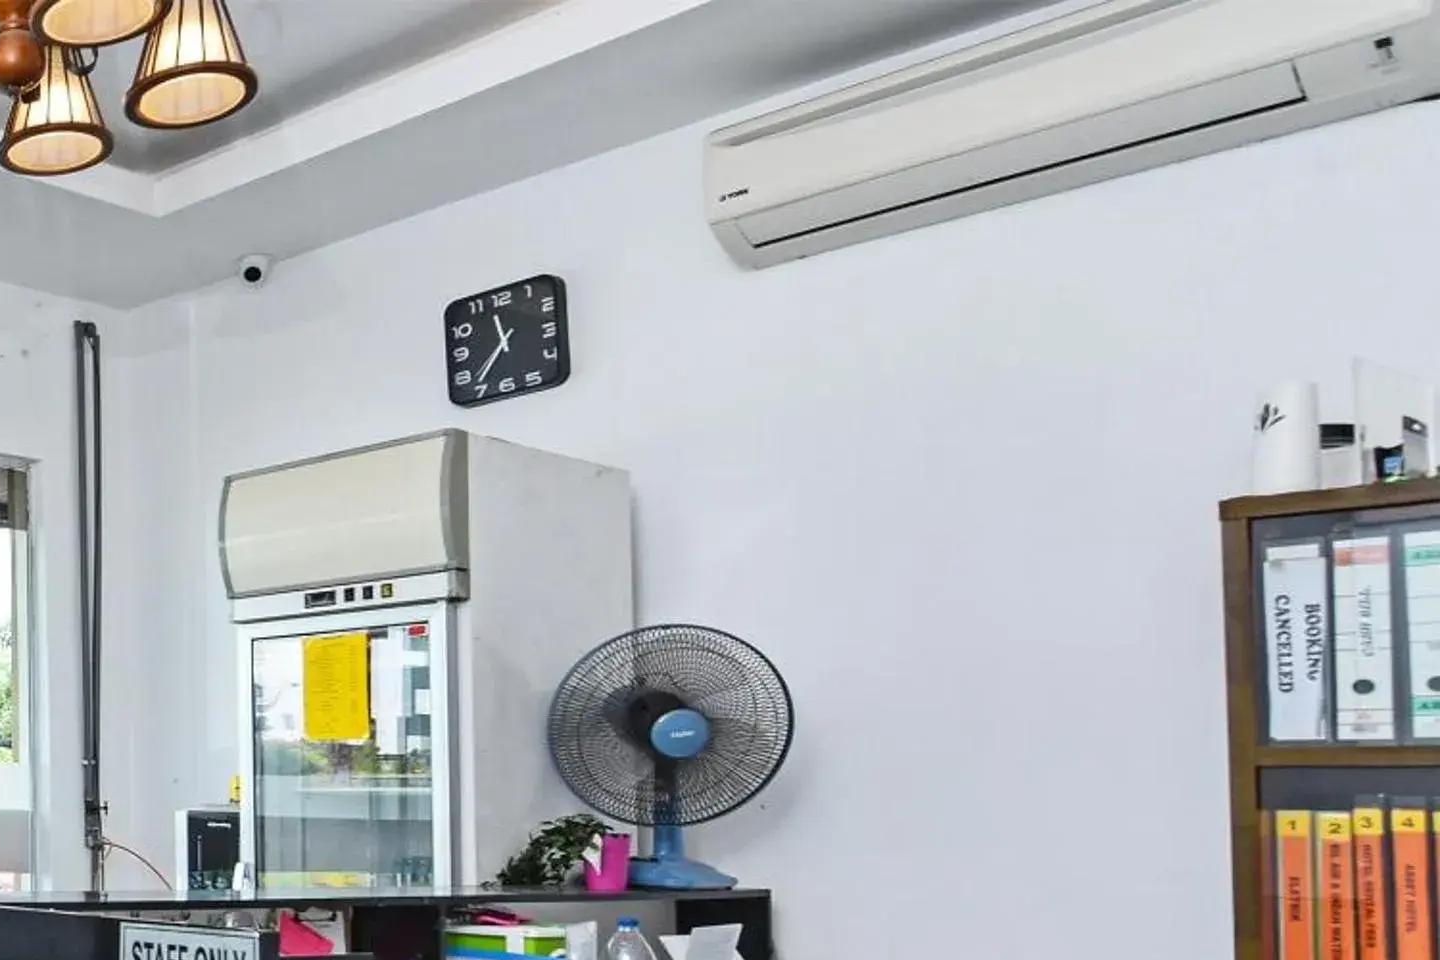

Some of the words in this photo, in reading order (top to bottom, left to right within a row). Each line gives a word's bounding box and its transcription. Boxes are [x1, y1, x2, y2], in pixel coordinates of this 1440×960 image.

[491, 290, 512, 307] 12
[524, 284, 532, 298] 1
[468, 299, 484, 314] 11
[541, 296, 555, 312] 2
[451, 323, 473, 339] 10
[541, 321, 556, 338] 3
[453, 347, 469, 362] 9
[454, 370, 471, 385] 8
[498, 377, 515, 392] 6
[525, 371, 542, 386] 5
[474, 383, 488, 398] 7
[1274, 594, 1294, 694] CANCELLED
[1287, 820, 1297, 830] 1
[1328, 822, 1342, 834] 2
[1360, 816, 1374, 828] 3
[1401, 817, 1415, 828] 4
